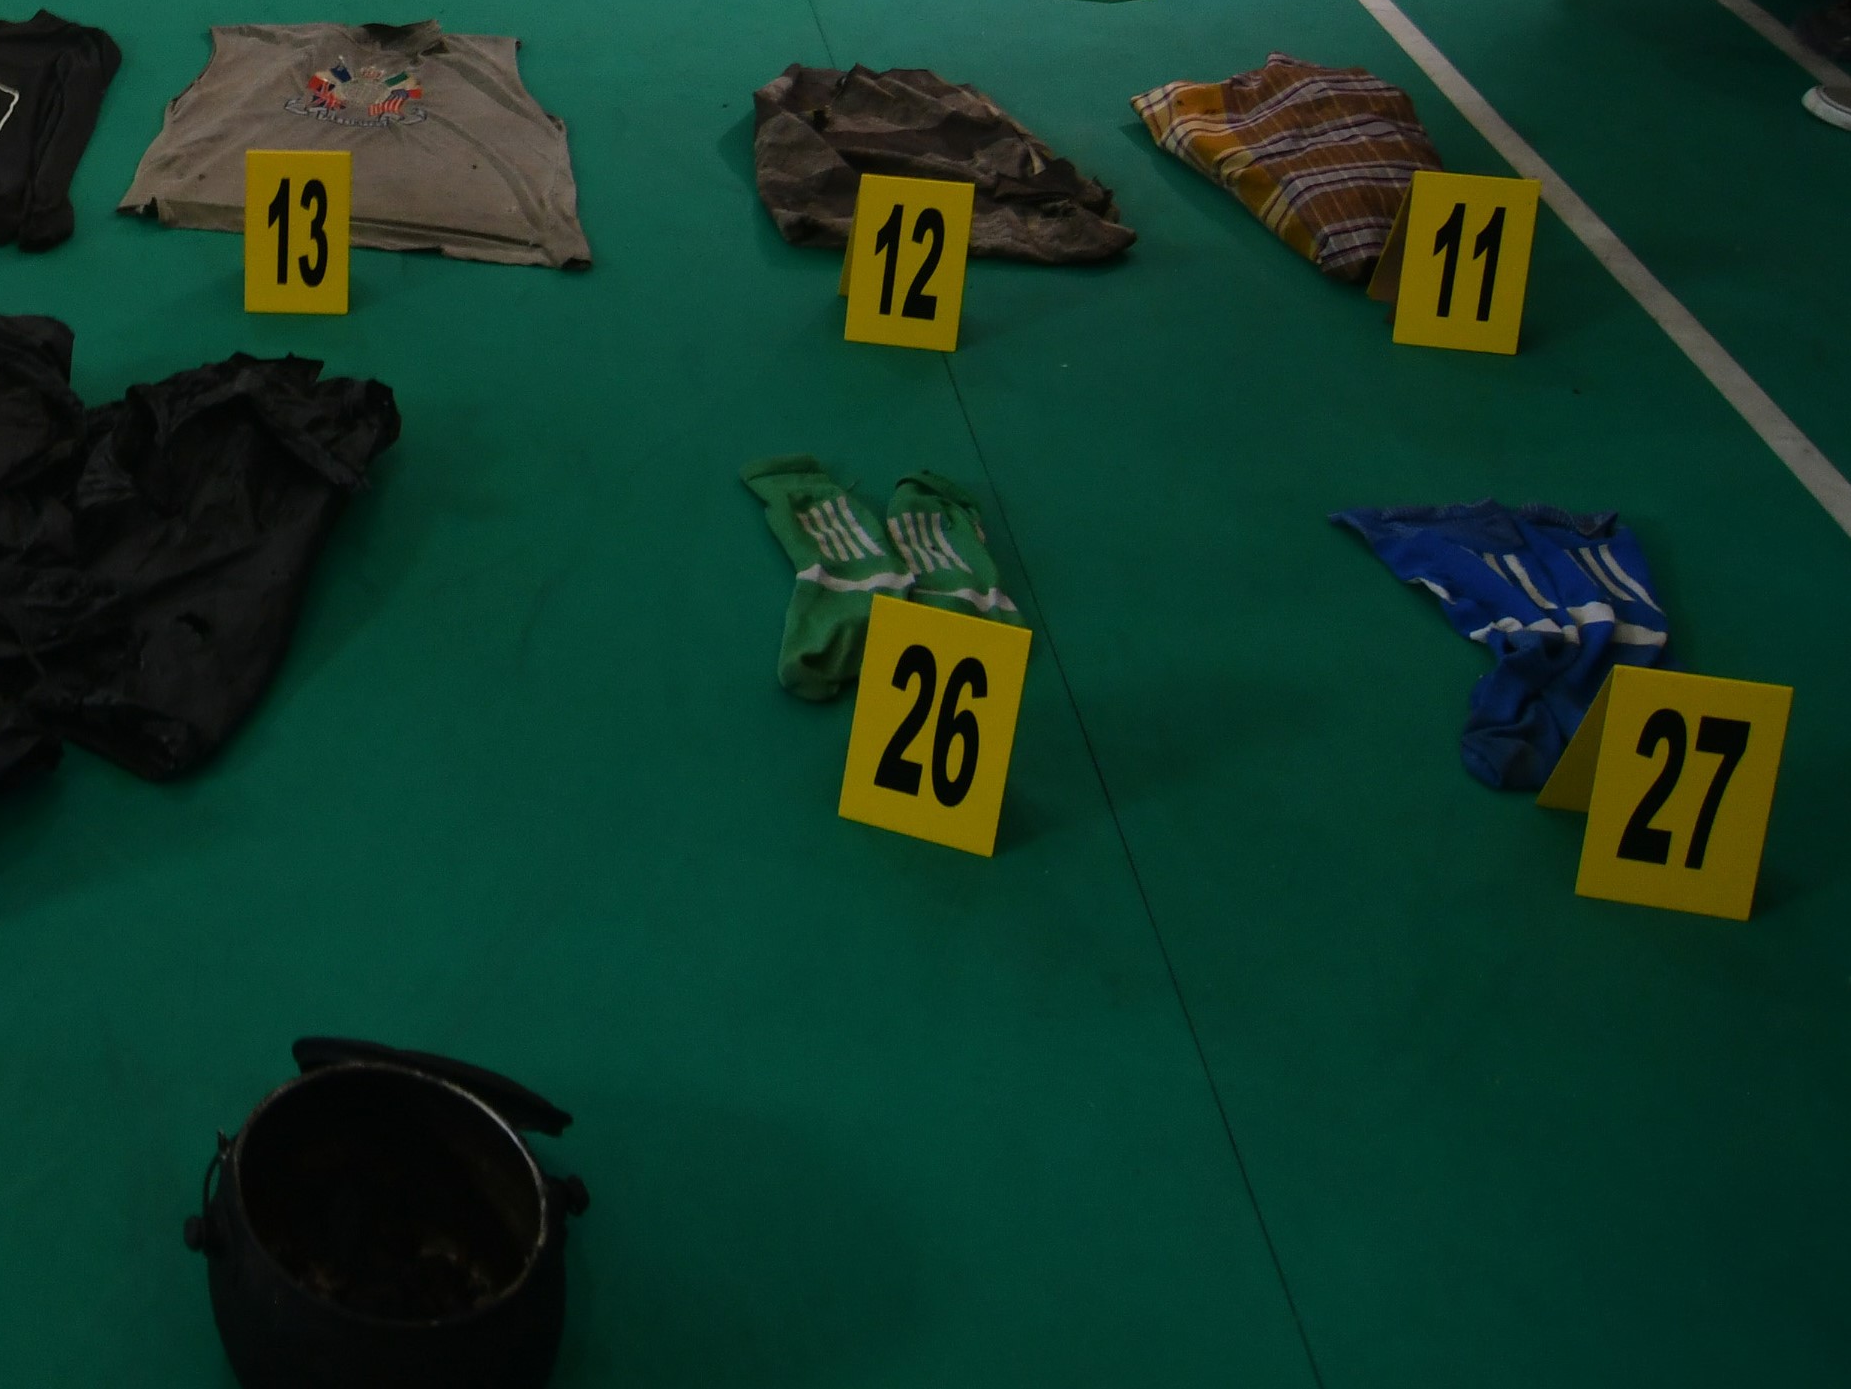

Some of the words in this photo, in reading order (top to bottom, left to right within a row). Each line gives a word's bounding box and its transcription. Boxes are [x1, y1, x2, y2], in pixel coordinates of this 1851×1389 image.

[268, 179, 328, 287] 13
[875, 204, 944, 320] 12
[1434, 203, 1506, 321] 11
[874, 645, 987, 807] 26
[1617, 709, 1751, 870] 27
